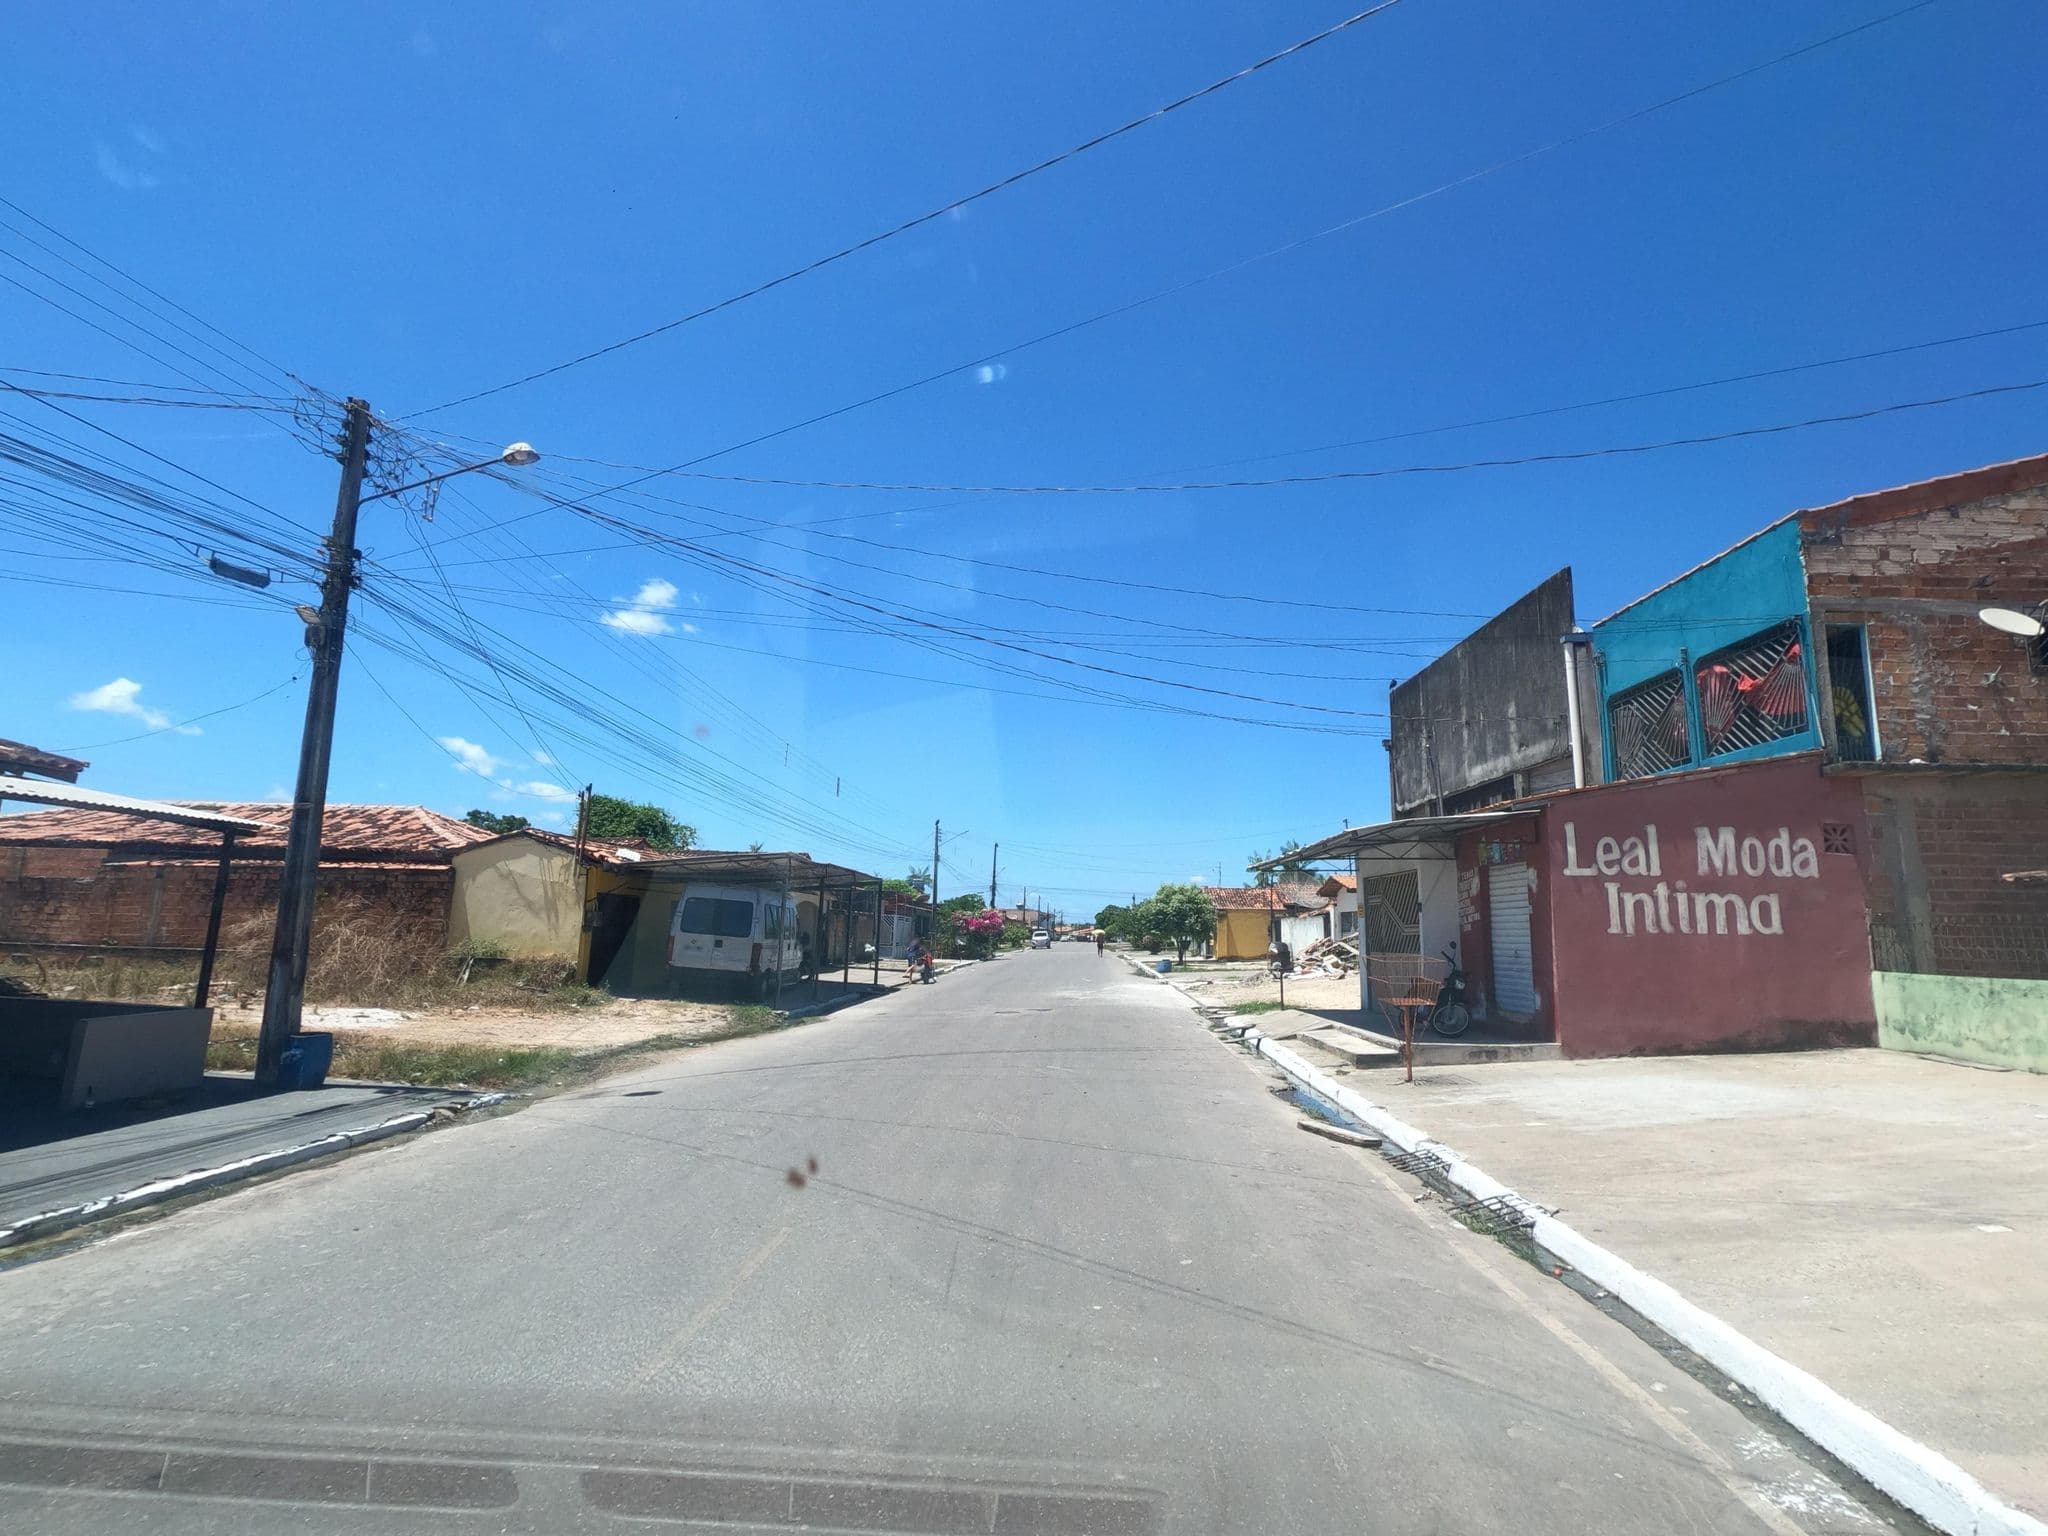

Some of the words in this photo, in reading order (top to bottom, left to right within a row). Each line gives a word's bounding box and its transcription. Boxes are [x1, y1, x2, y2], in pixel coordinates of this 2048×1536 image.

[1563, 822, 1662, 877] Leal
[1694, 826, 1819, 879] Moda
[1604, 880, 1784, 937] Intima
